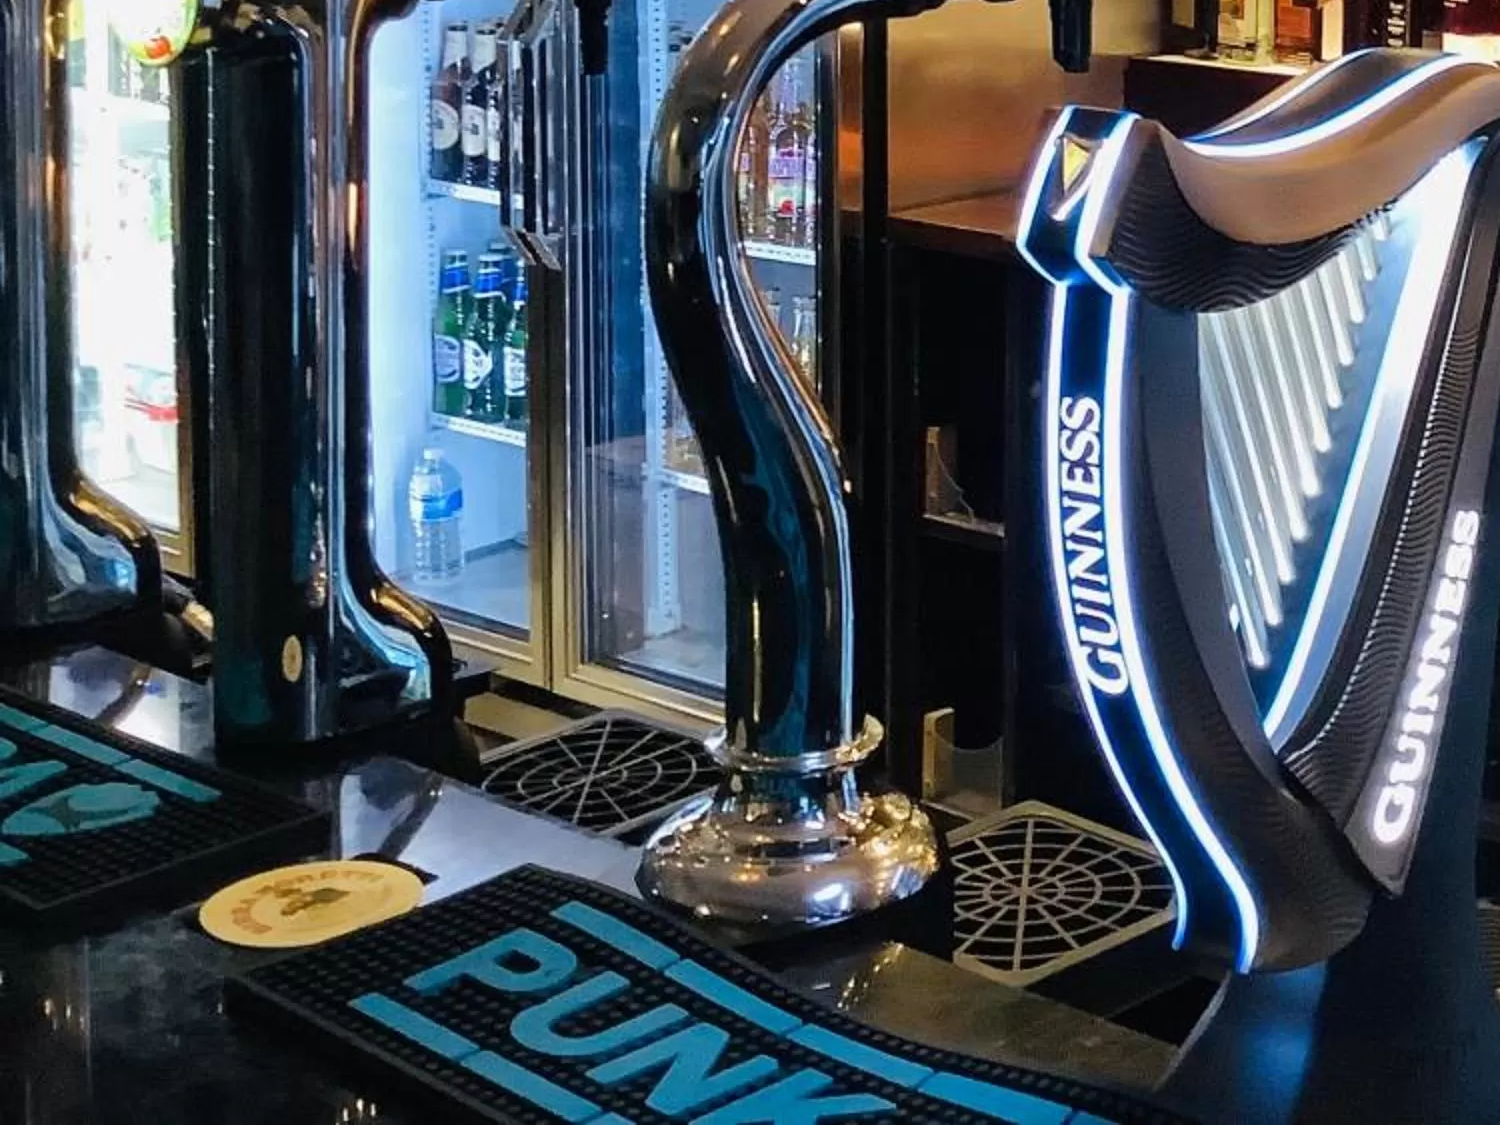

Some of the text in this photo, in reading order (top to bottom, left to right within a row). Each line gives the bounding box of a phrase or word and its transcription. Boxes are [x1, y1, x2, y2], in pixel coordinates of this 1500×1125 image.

[1060, 396, 1131, 696] GUINNESS
[1373, 509, 1481, 844] GUINNESS
[402, 926, 897, 1125] PUNK
